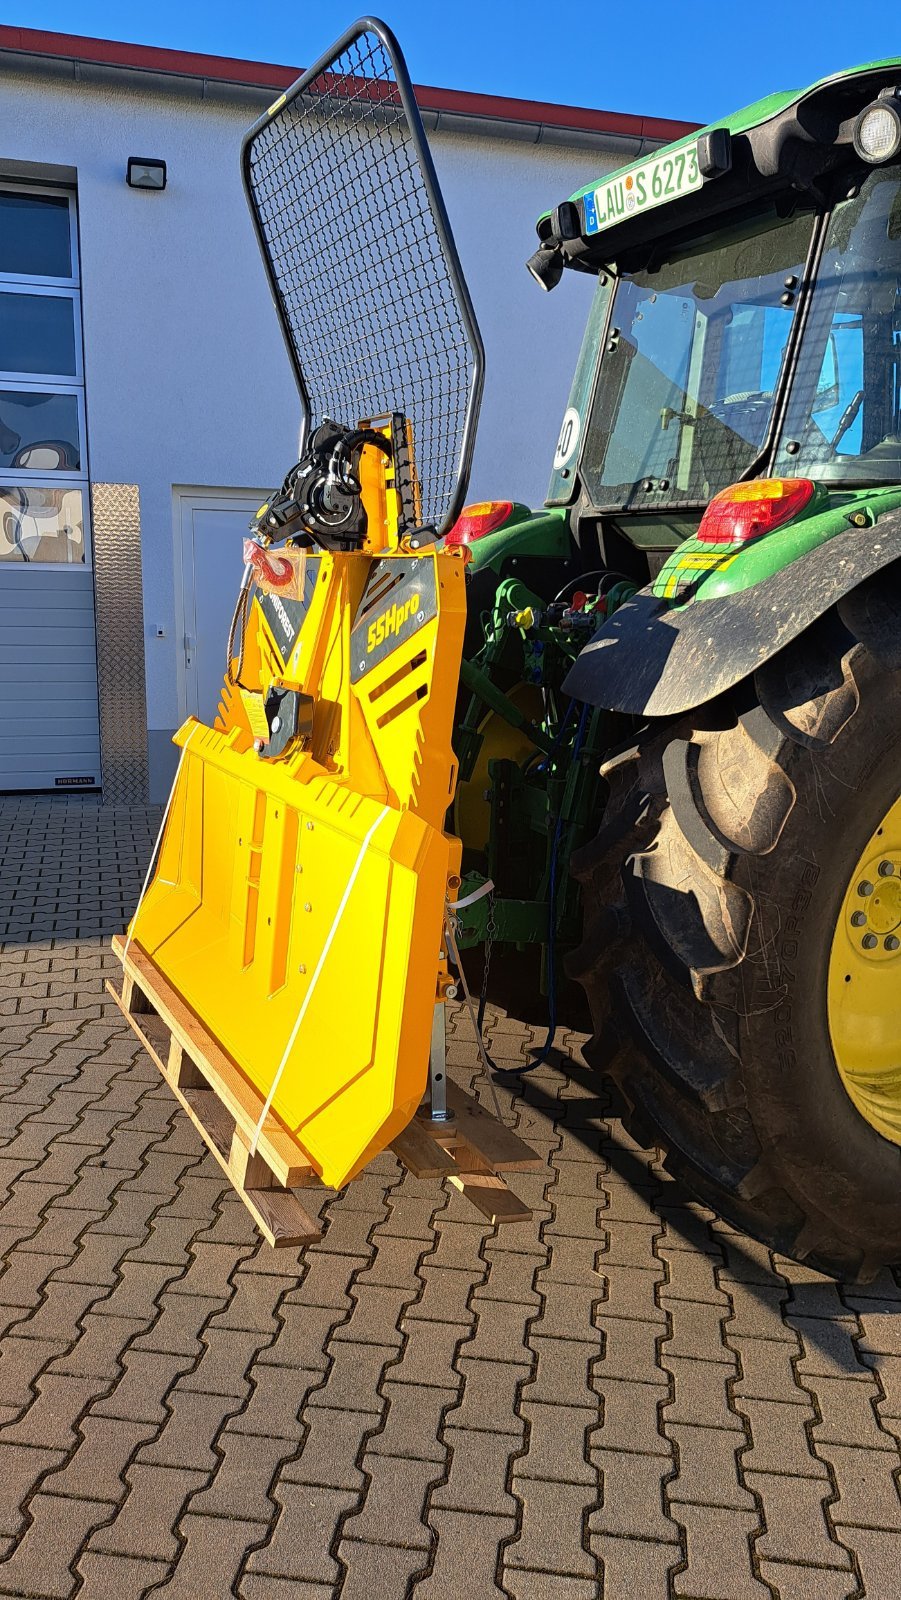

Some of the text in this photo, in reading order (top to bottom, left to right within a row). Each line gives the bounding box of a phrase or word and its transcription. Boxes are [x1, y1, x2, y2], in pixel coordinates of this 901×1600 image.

[595, 147, 699, 224] LAU S 6273
[367, 593, 420, 653] 55Hpro
